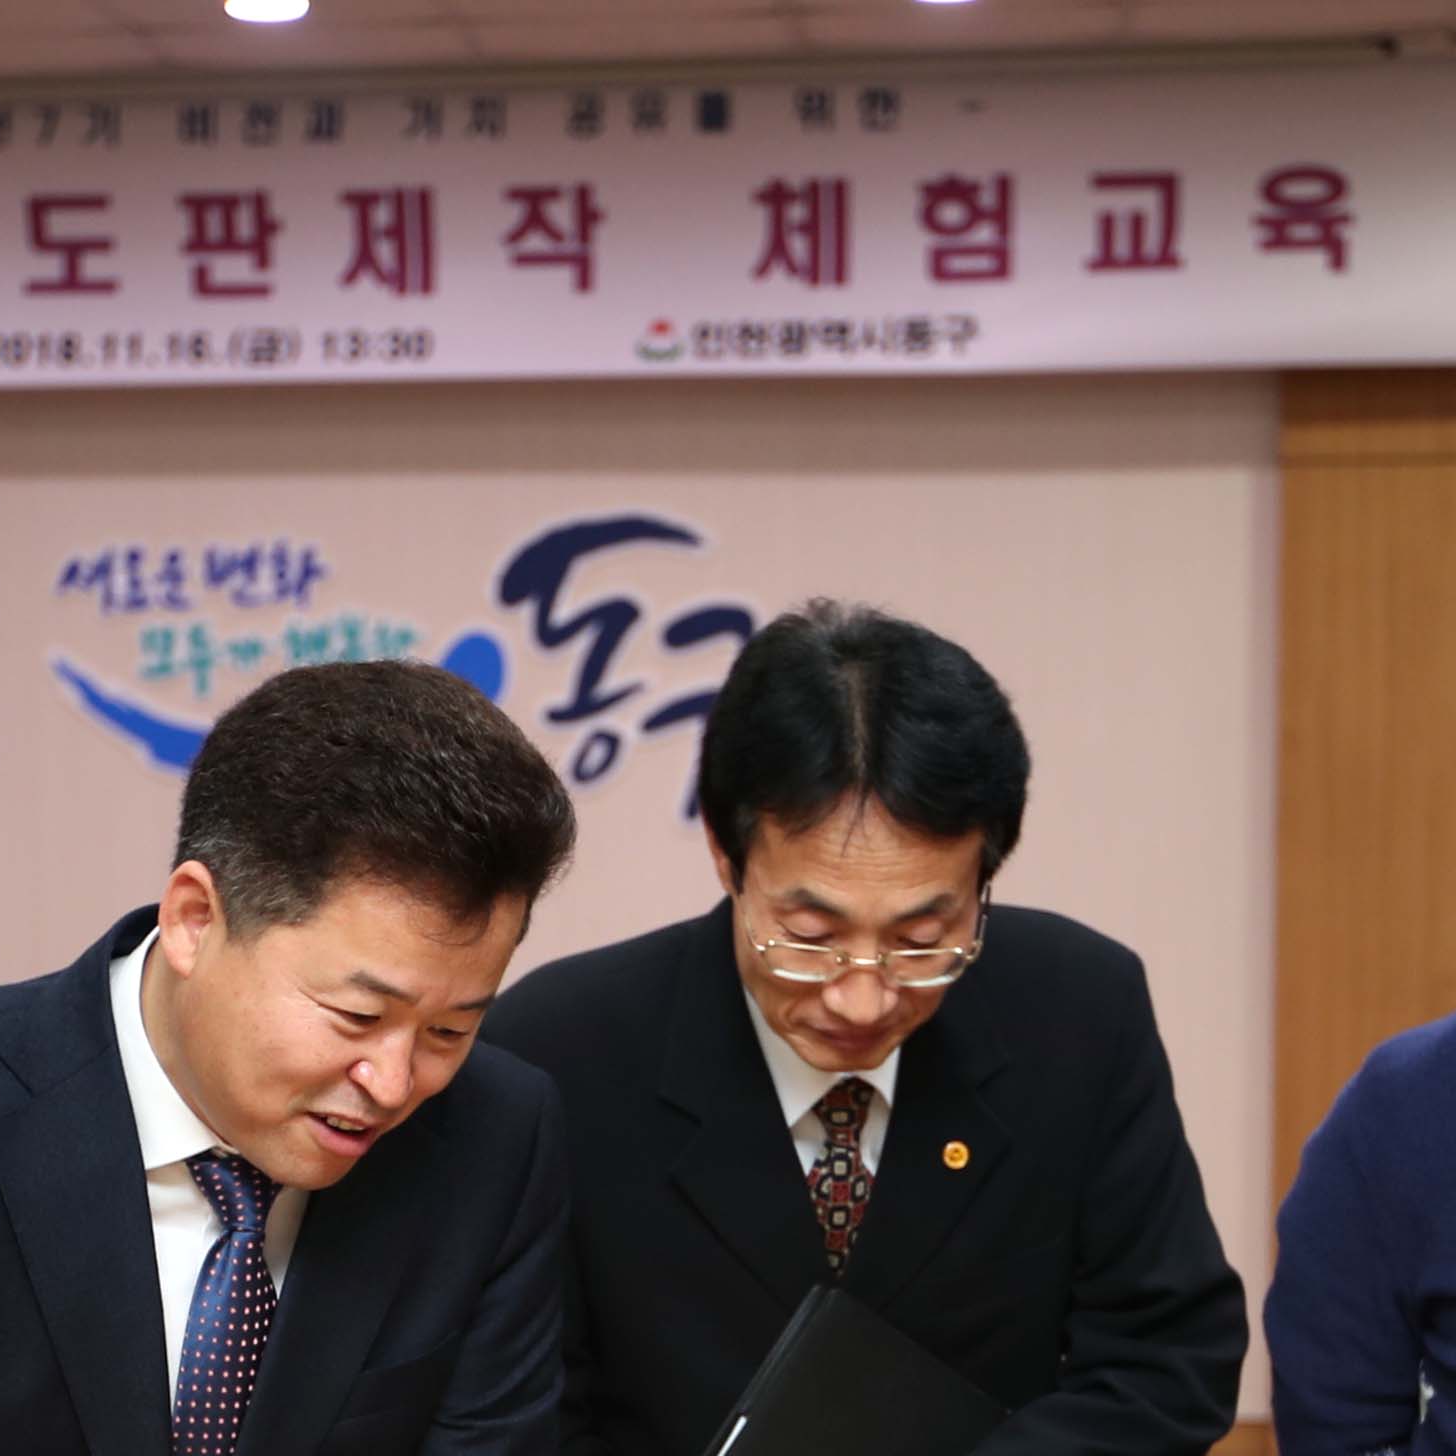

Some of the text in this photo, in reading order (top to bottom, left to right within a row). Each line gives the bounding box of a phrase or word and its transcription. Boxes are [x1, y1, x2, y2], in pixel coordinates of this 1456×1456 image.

[18, 180, 608, 302] 도판제작
[748, 160, 1356, 290] 체험교육
[202, 540, 329, 609] 변화
